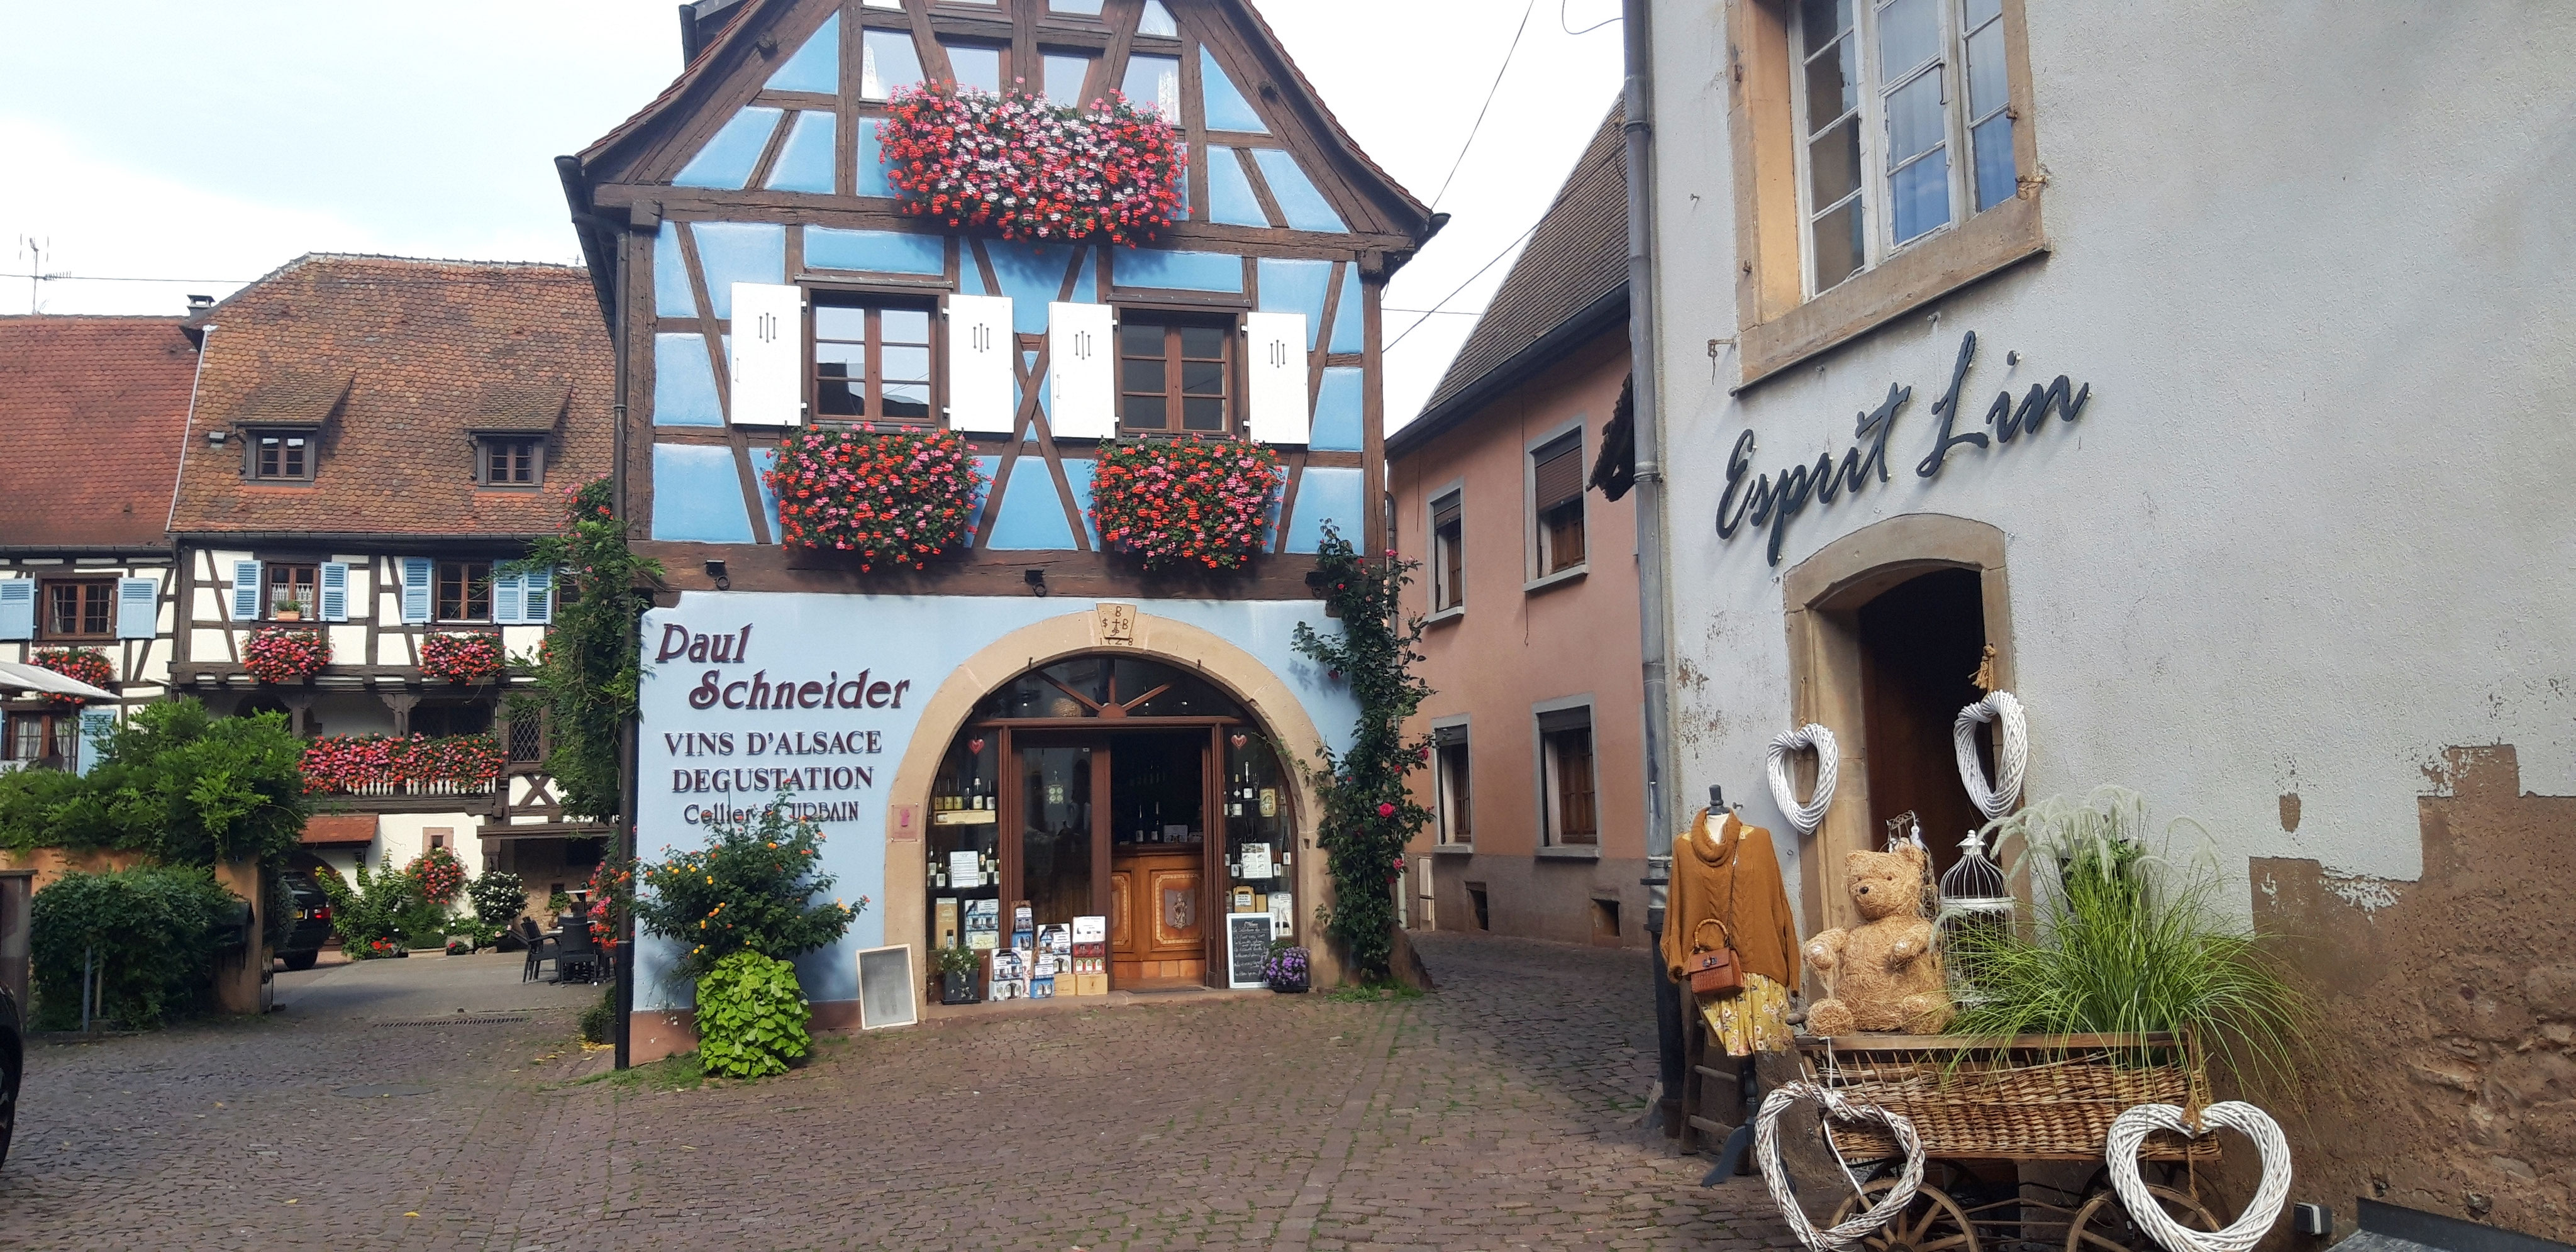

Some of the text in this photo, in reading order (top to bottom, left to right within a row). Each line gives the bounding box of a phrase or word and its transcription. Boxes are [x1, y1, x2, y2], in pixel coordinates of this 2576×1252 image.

[1715, 330, 2090, 567] Esprit Lin
[655, 623, 753, 663] Paul
[689, 668, 910, 709] Schneider
[664, 730, 882, 756] VINS D'ALSACE
[672, 766, 874, 792] DEGUSTATION
